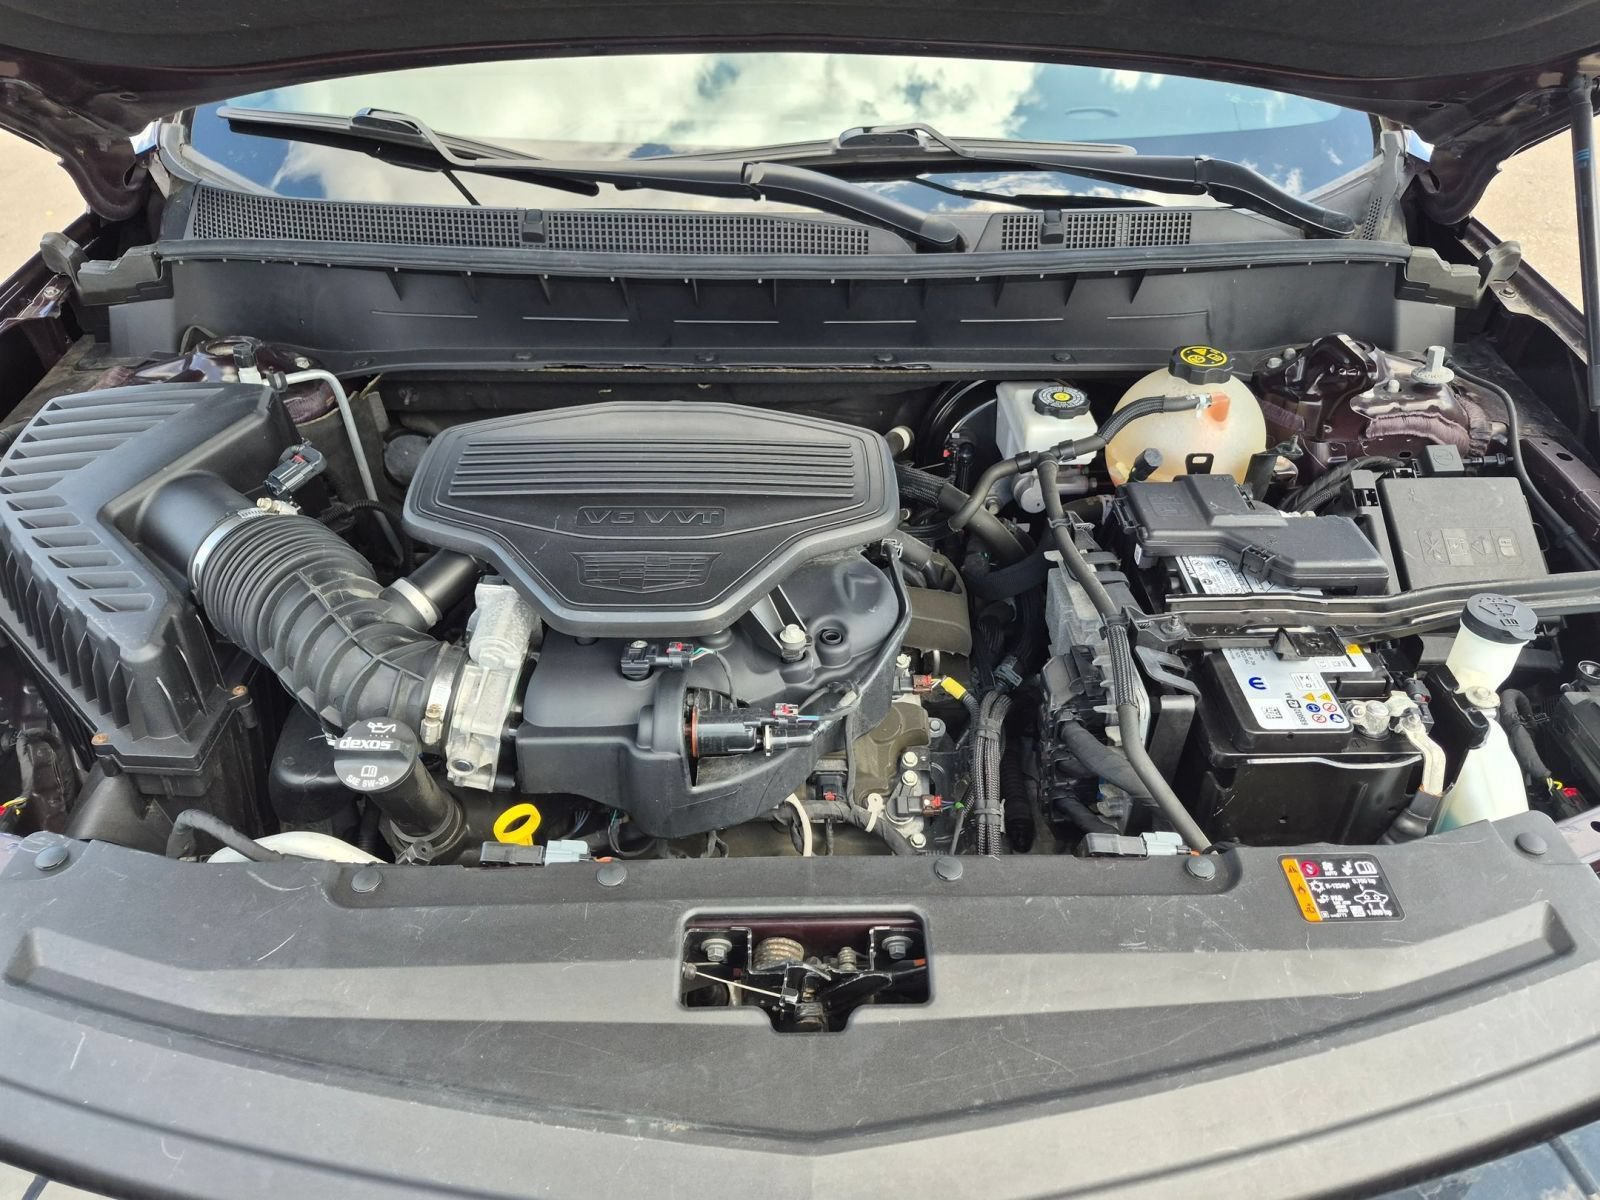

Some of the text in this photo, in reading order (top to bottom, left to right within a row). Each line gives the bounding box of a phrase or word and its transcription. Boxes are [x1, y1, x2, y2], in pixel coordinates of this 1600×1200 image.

[584, 510, 720, 523] V6 VVT
[339, 737, 394, 749] dexos
